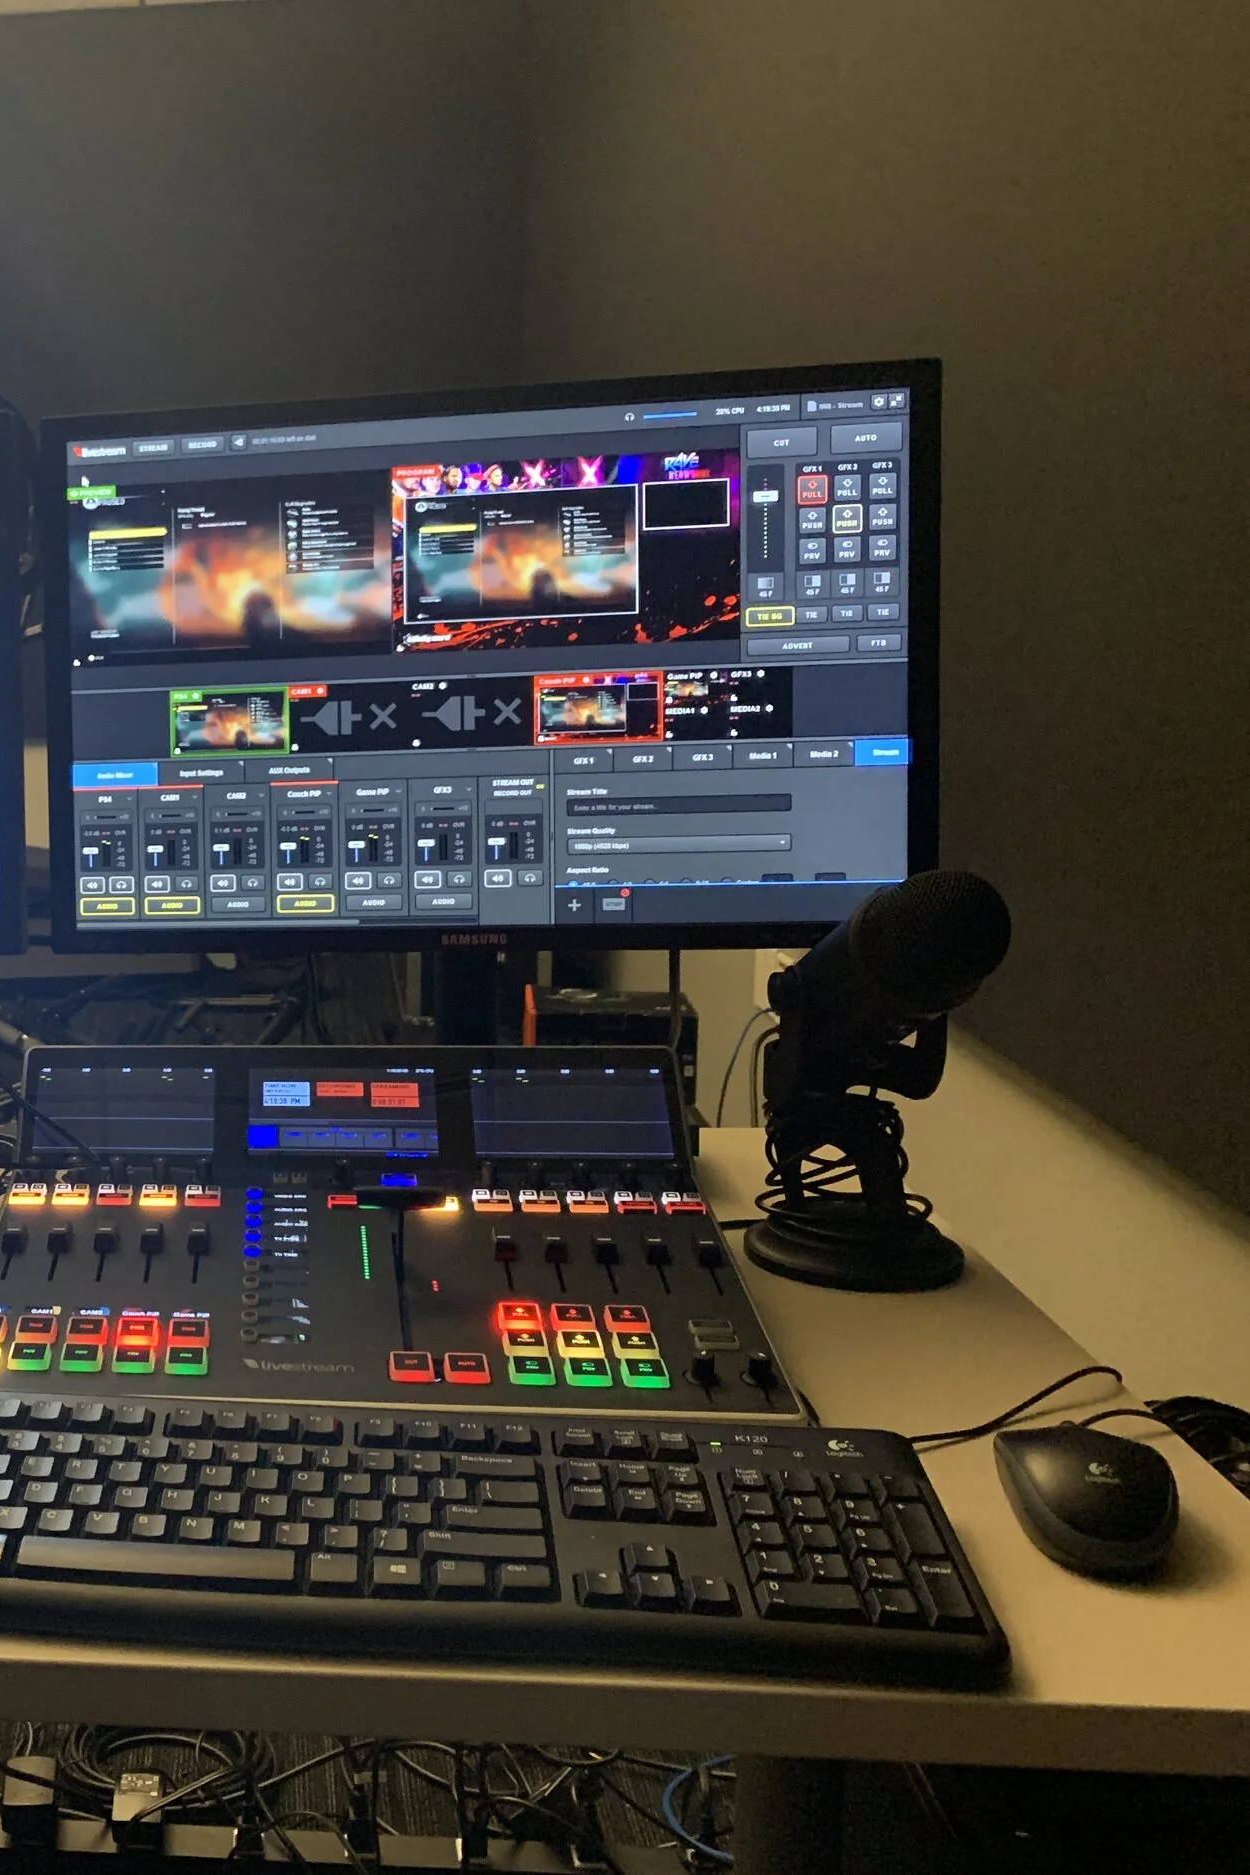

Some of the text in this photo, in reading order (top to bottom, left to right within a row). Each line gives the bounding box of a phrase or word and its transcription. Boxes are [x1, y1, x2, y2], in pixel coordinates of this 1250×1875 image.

[731, 407, 745, 415] CPU
[854, 434, 877, 442] AUTO
[188, 440, 218, 449] RECORD
[773, 439, 790, 447] CUT
[396, 468, 435, 478] PROGRAM
[837, 489, 857, 497] PULL
[836, 520, 857, 528] PUSH
[872, 518, 893, 526] PUSH
[782, 642, 813, 650] ADVERT
[688, 671, 703, 680] PIP
[749, 752, 771, 760] Media
[573, 757, 587, 765] GFX
[197, 769, 224, 777] Settings
[492, 778, 535, 787] STREAM OUT
[309, 790, 322, 798] PIP
[377, 788, 390, 796] PIP
[592, 827, 616, 836] Quality
[566, 867, 591, 875] Aspect
[441, 933, 508, 945] SAMSUNG
[290, 1097, 301, 1105] PM
[734, 1435, 769, 1443] K120
[461, 1454, 513, 1463] Backspace
[675, 1497, 702, 1505] Down
[452, 1506, 479, 1514] Enter
[428, 1531, 452, 1539] Shift
[921, 1565, 951, 1574] Enter
